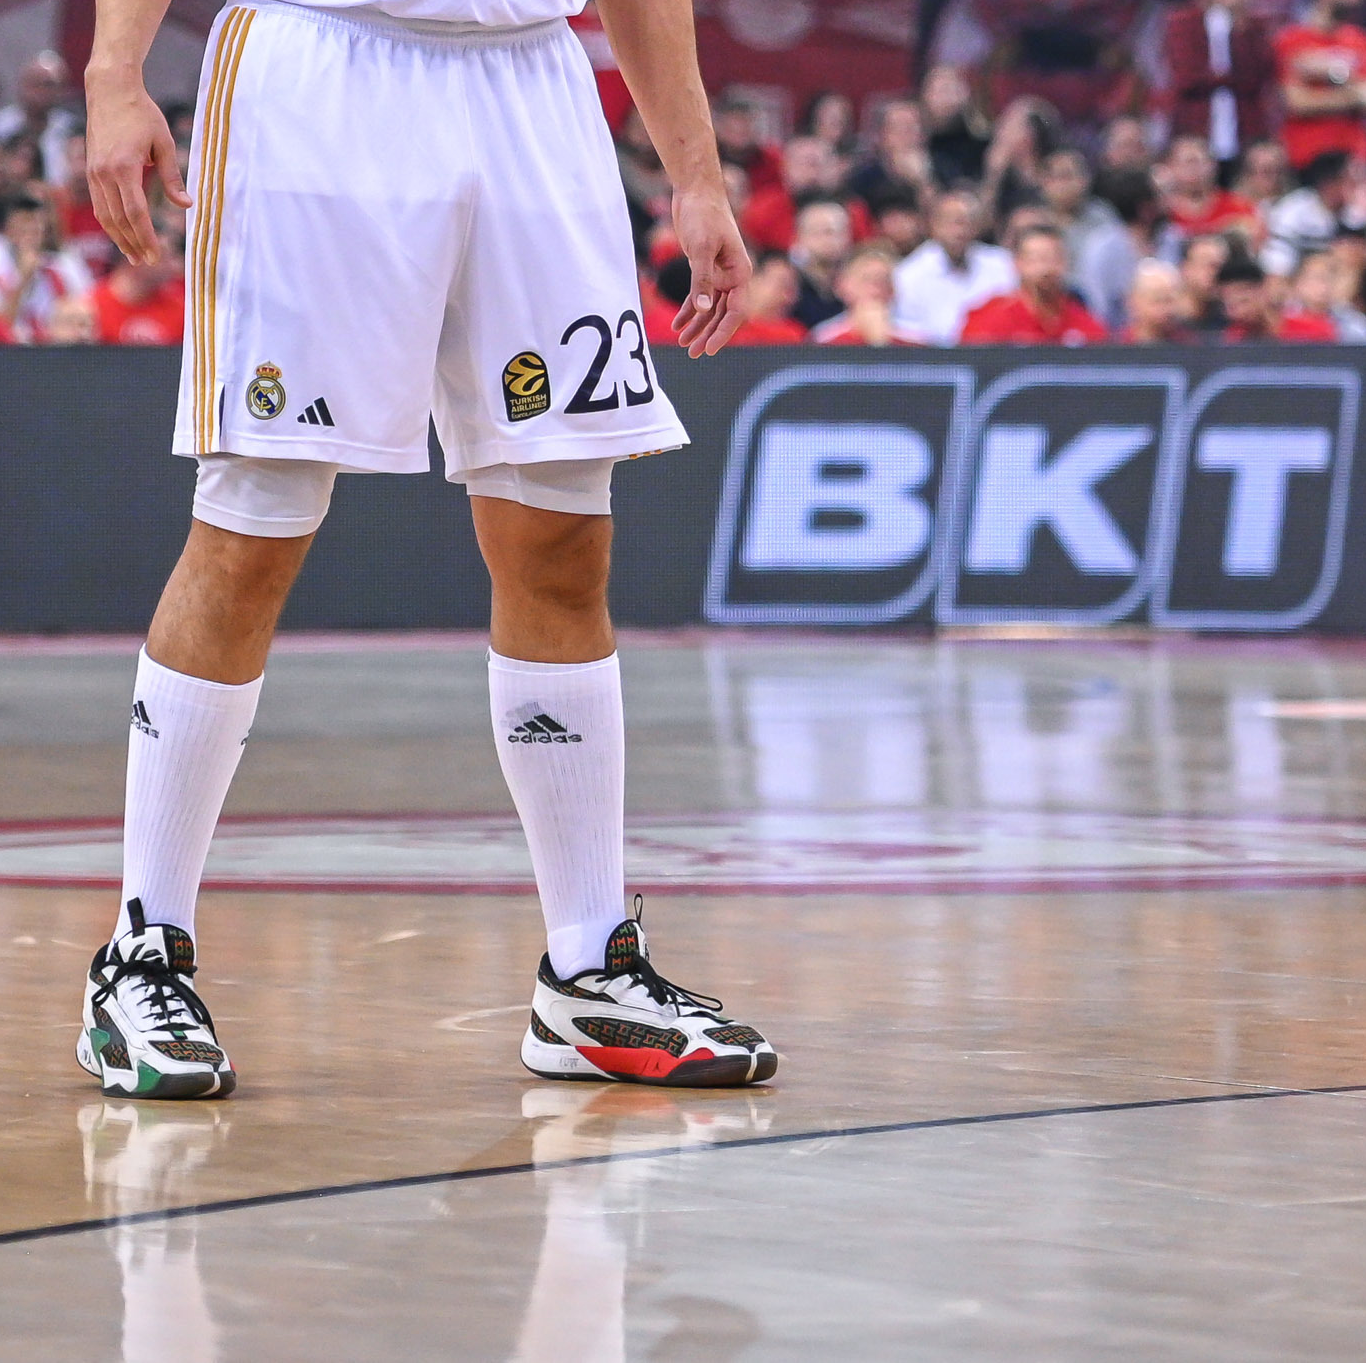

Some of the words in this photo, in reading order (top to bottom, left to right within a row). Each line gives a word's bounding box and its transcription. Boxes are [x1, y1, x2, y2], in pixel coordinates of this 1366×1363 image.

[559, 309, 656, 415] 23
[510, 393, 547, 406] TURKISH
[511, 401, 547, 413] AIRLINES
[737, 420, 1333, 578] BKT
[507, 732, 583, 744] adidas
